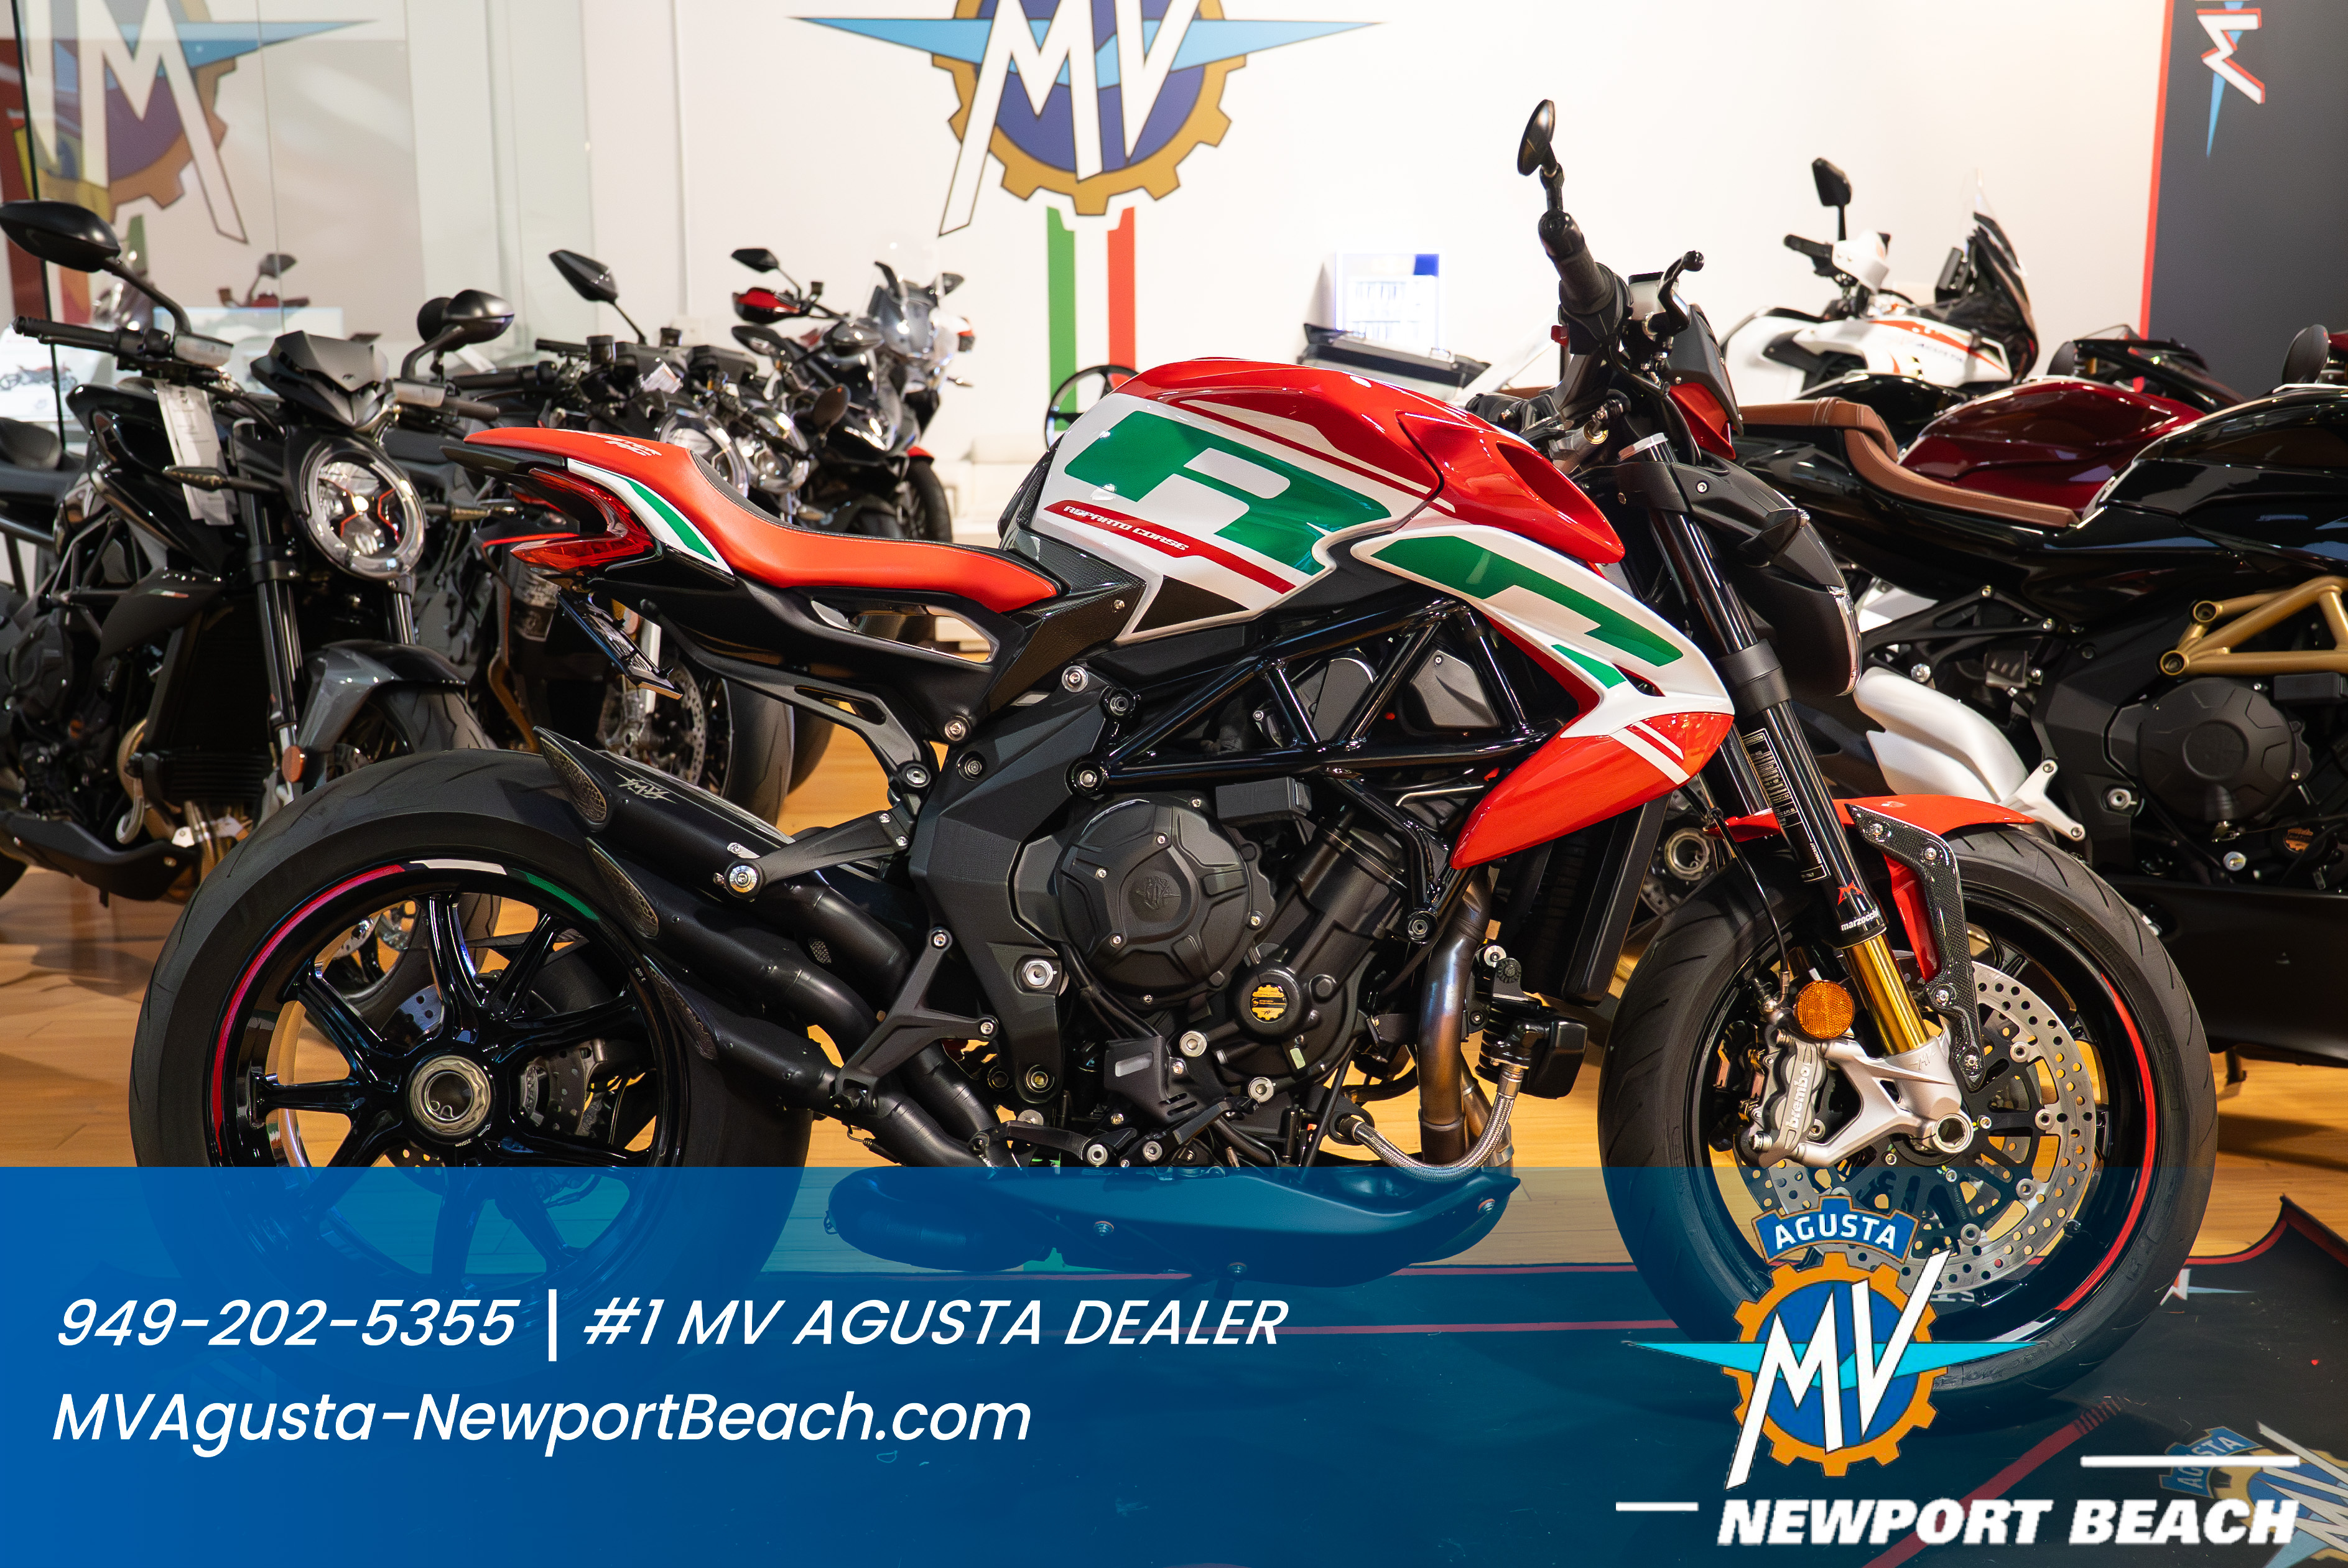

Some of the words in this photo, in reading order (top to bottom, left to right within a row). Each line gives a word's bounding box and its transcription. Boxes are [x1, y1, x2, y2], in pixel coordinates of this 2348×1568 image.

[1063, 505, 1133, 531] REPARTO
[1131, 527, 1189, 550] CORSE
[1840, 907, 1880, 931] marzocchi
[1784, 1067, 1811, 1129] brembo
